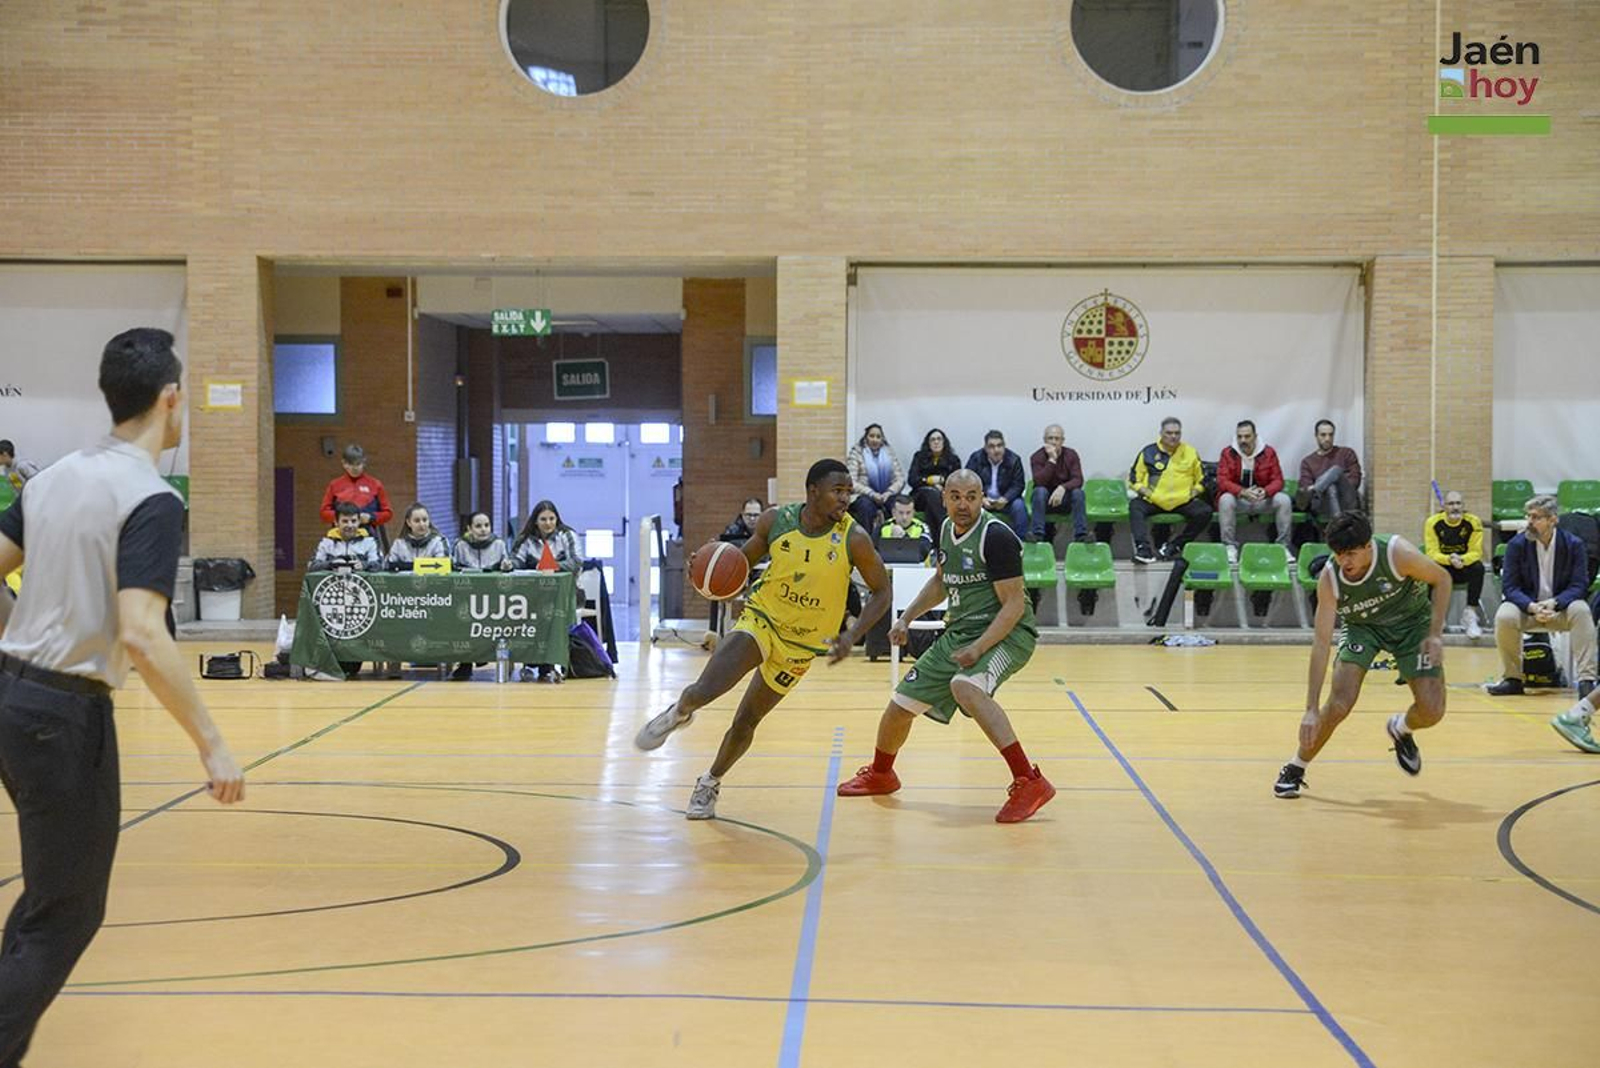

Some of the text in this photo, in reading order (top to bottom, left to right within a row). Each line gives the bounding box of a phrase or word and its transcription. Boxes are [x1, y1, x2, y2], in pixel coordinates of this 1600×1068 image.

[493, 310, 525, 321] SALIDA
[562, 373, 601, 386] SALIDA
[804, 549, 810, 563] 1
[380, 592, 453, 607] Universidad
[780, 582, 821, 608] Jaén
[380, 606, 428, 619] de Jaén
[470, 622, 537, 641] Deporte
